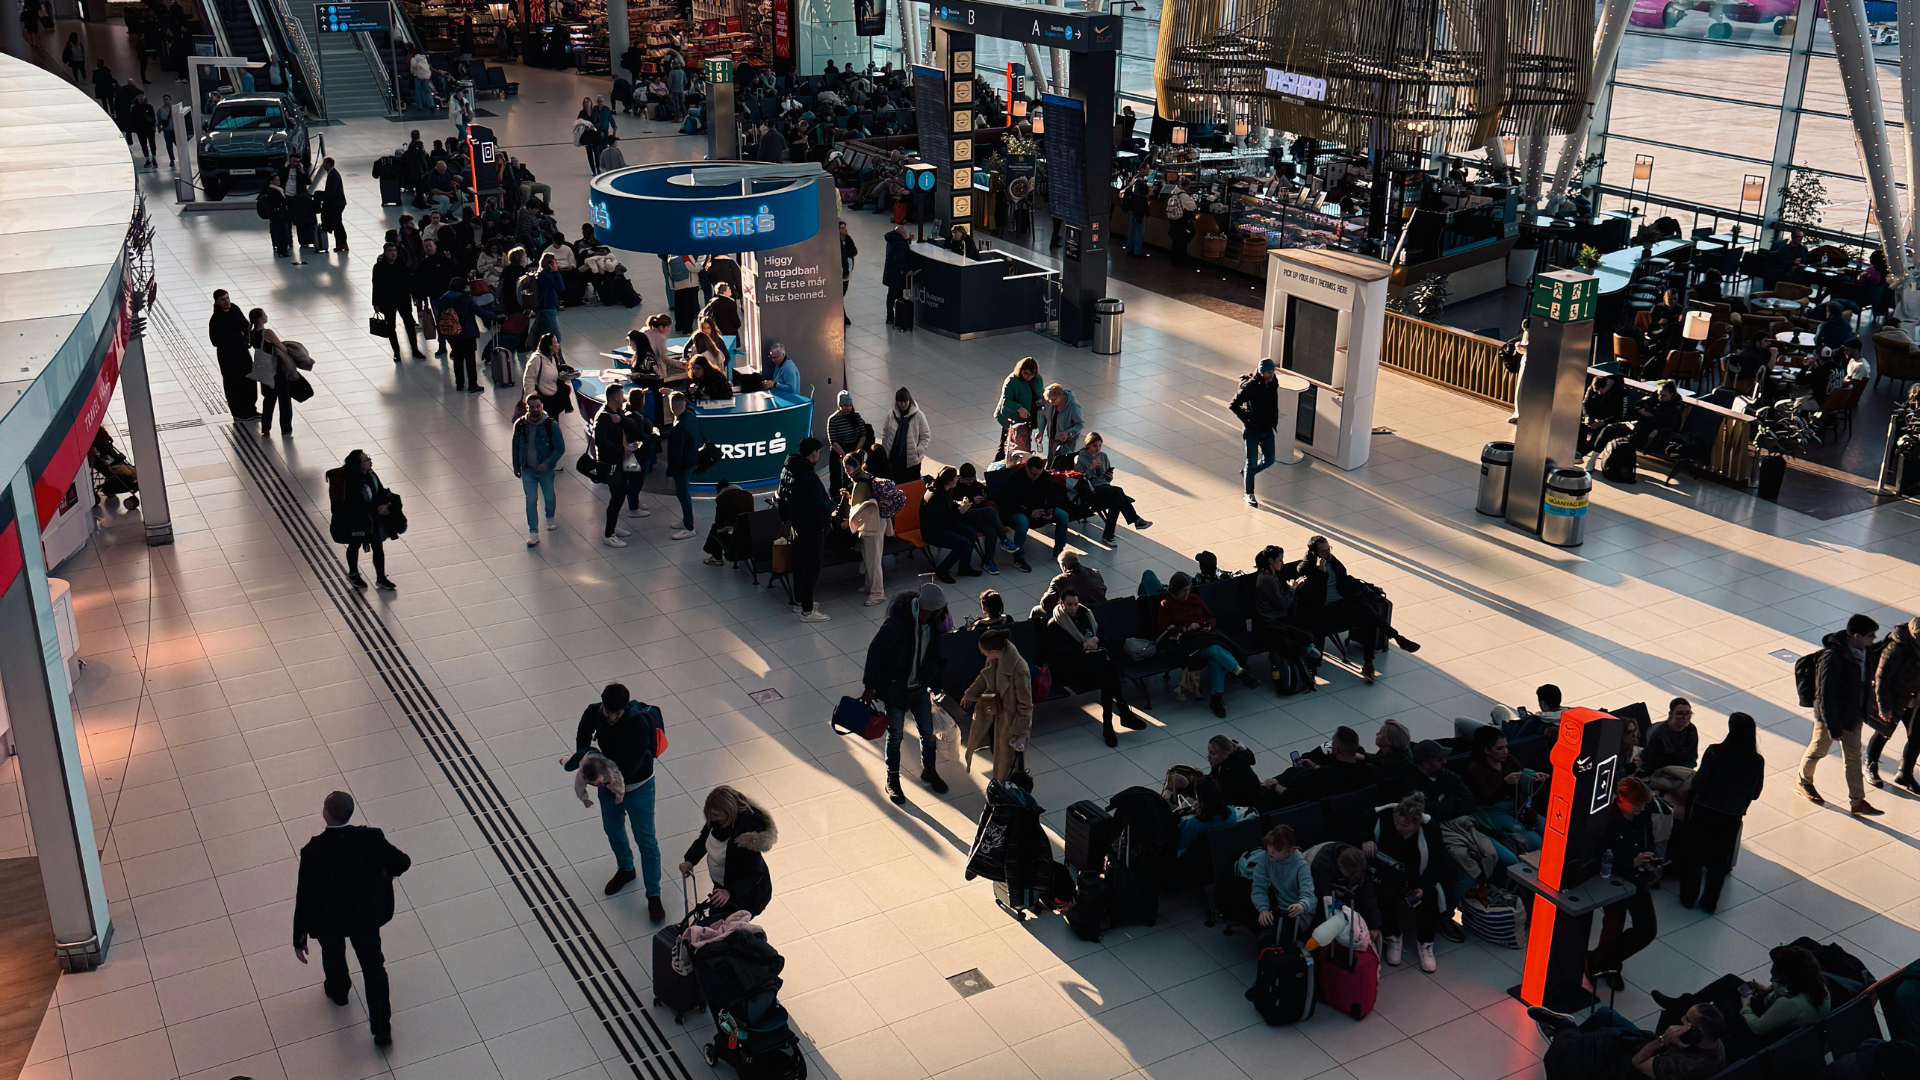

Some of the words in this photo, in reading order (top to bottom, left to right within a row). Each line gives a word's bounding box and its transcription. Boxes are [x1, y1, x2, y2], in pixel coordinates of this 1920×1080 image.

[968, 9, 975, 25] B
[1031, 19, 1041, 37] A
[693, 216, 755, 238] ERSTE
[764, 255, 793, 267] Higgy
[764, 265, 819, 279] magadban!
[765, 281, 778, 291] Az
[780, 279, 806, 289] Erste
[807, 276, 827, 287] már
[1283, 268, 1292, 277] PICK
[1293, 271, 1298, 279] UP
[1299, 273, 1309, 283] YOUR
[1309, 276, 1318, 285] GIFT
[1318, 278, 1336, 291] THERMOS
[1337, 284, 1348, 294] HERE
[765, 293, 786, 303] hisz
[787, 289, 827, 301] benned.
[714, 440, 767, 460] RSTE
